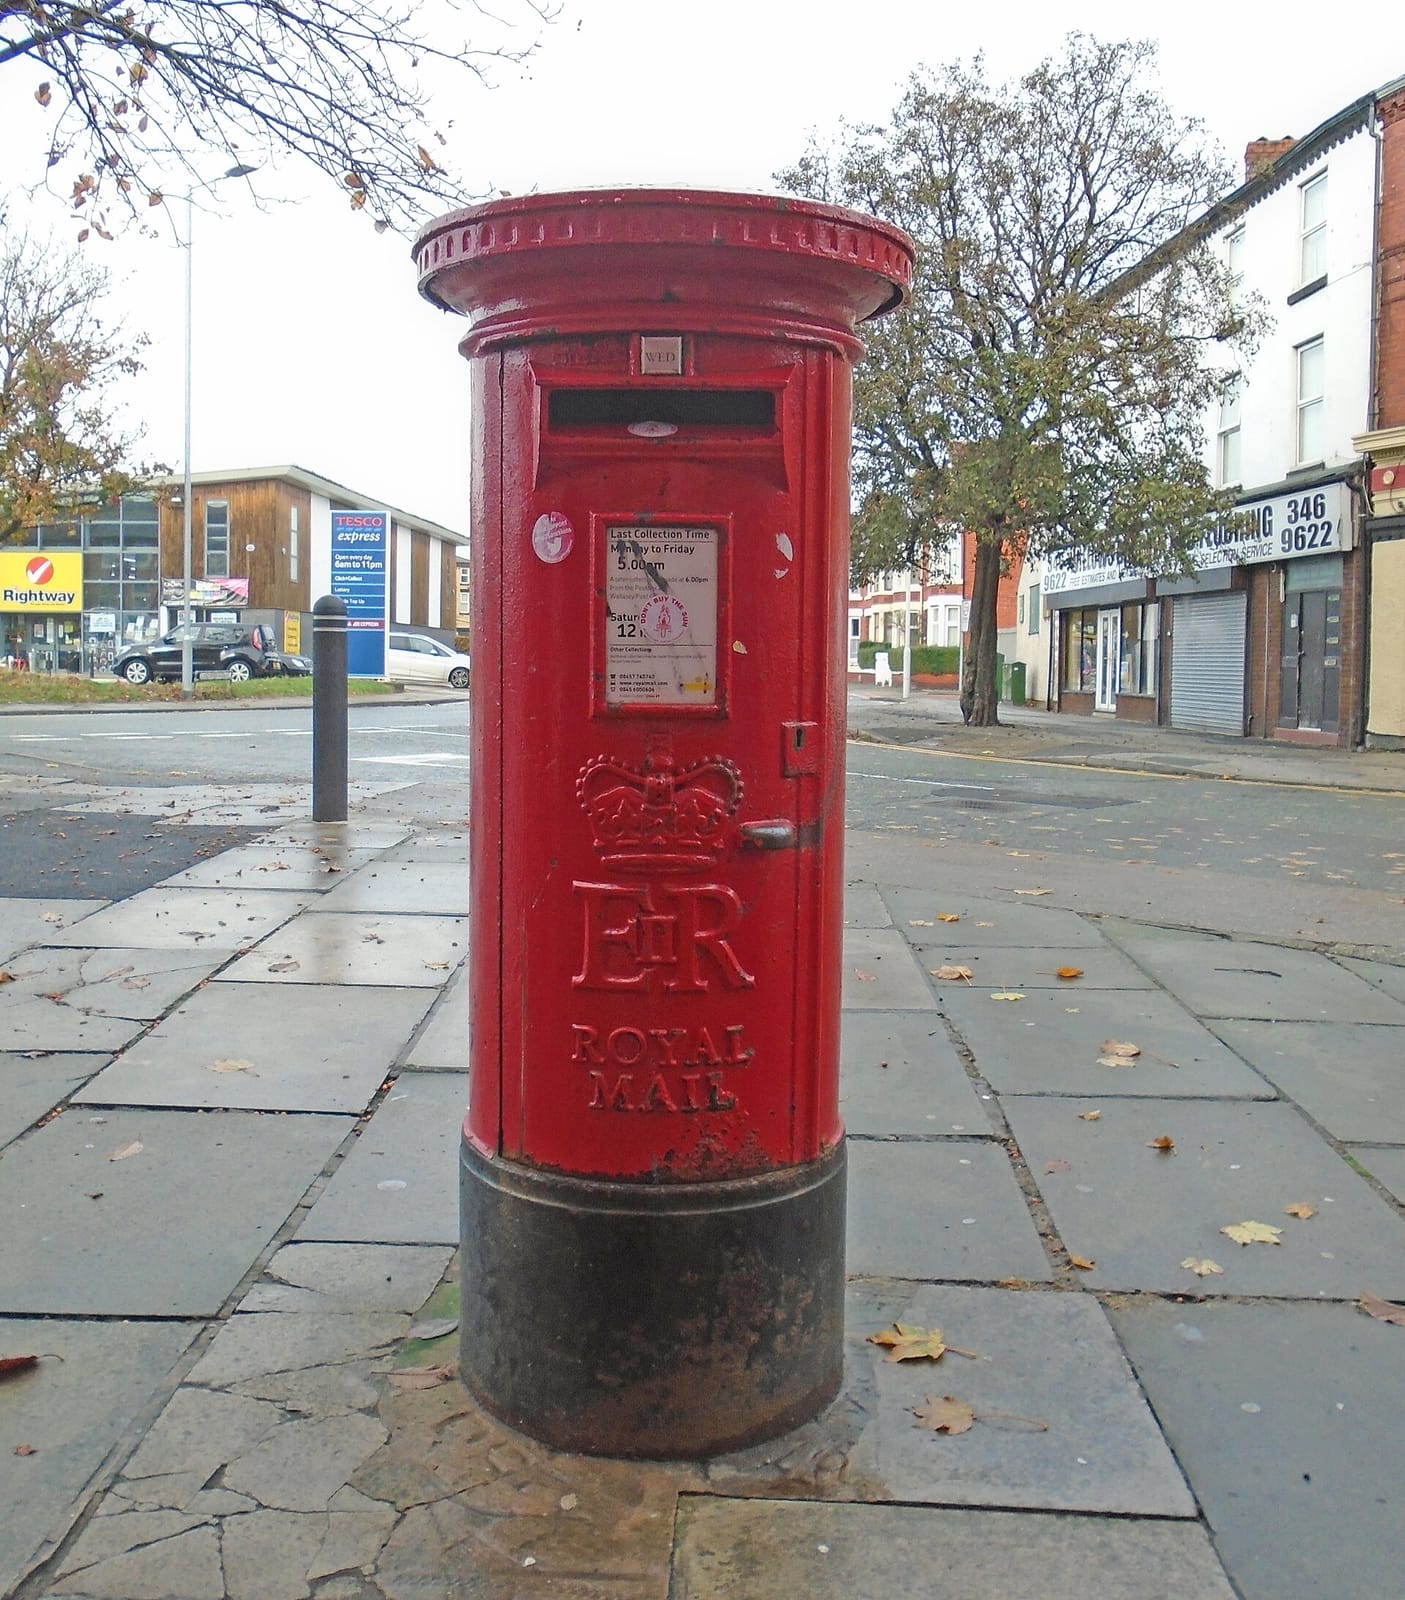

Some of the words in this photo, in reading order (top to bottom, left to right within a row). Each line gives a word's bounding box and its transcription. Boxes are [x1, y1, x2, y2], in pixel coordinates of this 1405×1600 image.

[644, 351, 676, 363] WED
[1287, 493, 1326, 525] 346
[335, 516, 383, 527] TESCO
[337, 532, 381, 544] express
[610, 529, 632, 539] Last
[634, 529, 683, 539] Collection
[684, 529, 710, 539] Time
[1281, 521, 1333, 553] 9622
[610, 544, 649, 555] Mnay
[651, 545, 662, 553] to
[663, 544, 695, 555] Friday
[1241, 542, 1274, 559] SERVICE
[361, 560, 383, 570] 11pm
[685, 576, 709, 584] 6.00pm
[1044, 572, 1067, 590] 9622
[3, 590, 75, 604] Rightway
[610, 612, 640, 622] Satur
[640, 602, 652, 624] DON'T
[653, 596, 669, 604] BUY
[671, 598, 684, 610] THE
[681, 611, 689, 628] SUN
[617, 623, 636, 638] 12
[571, 1023, 755, 1066] ROYAL
[587, 1070, 738, 1113] MAIL
